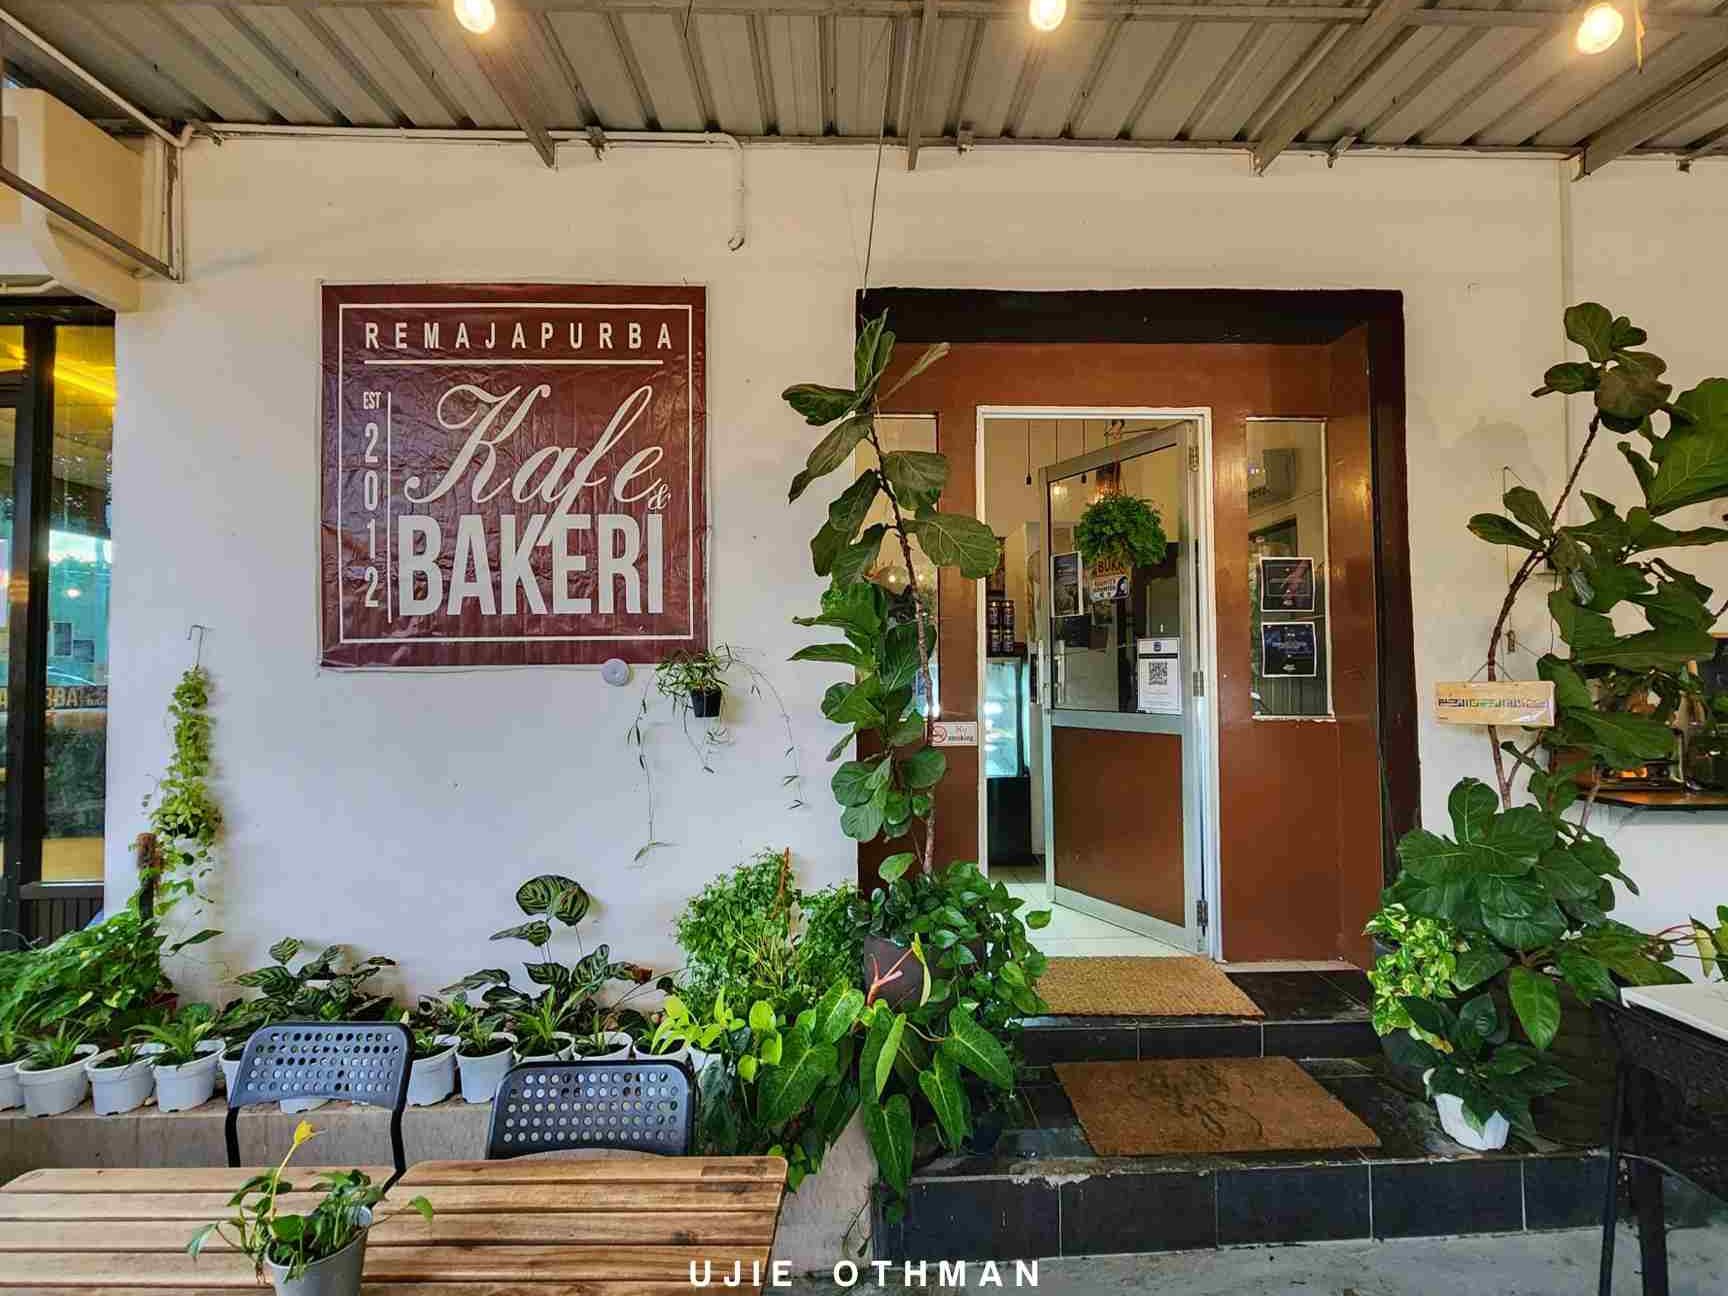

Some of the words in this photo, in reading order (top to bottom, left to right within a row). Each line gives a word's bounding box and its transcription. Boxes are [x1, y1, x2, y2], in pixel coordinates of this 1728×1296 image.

[365, 322, 672, 350] REMAJAPURBA
[363, 392, 382, 409] EST
[404, 384, 664, 546] Kafe
[647, 484, 672, 511] &
[399, 513, 664, 616] BAKERI
